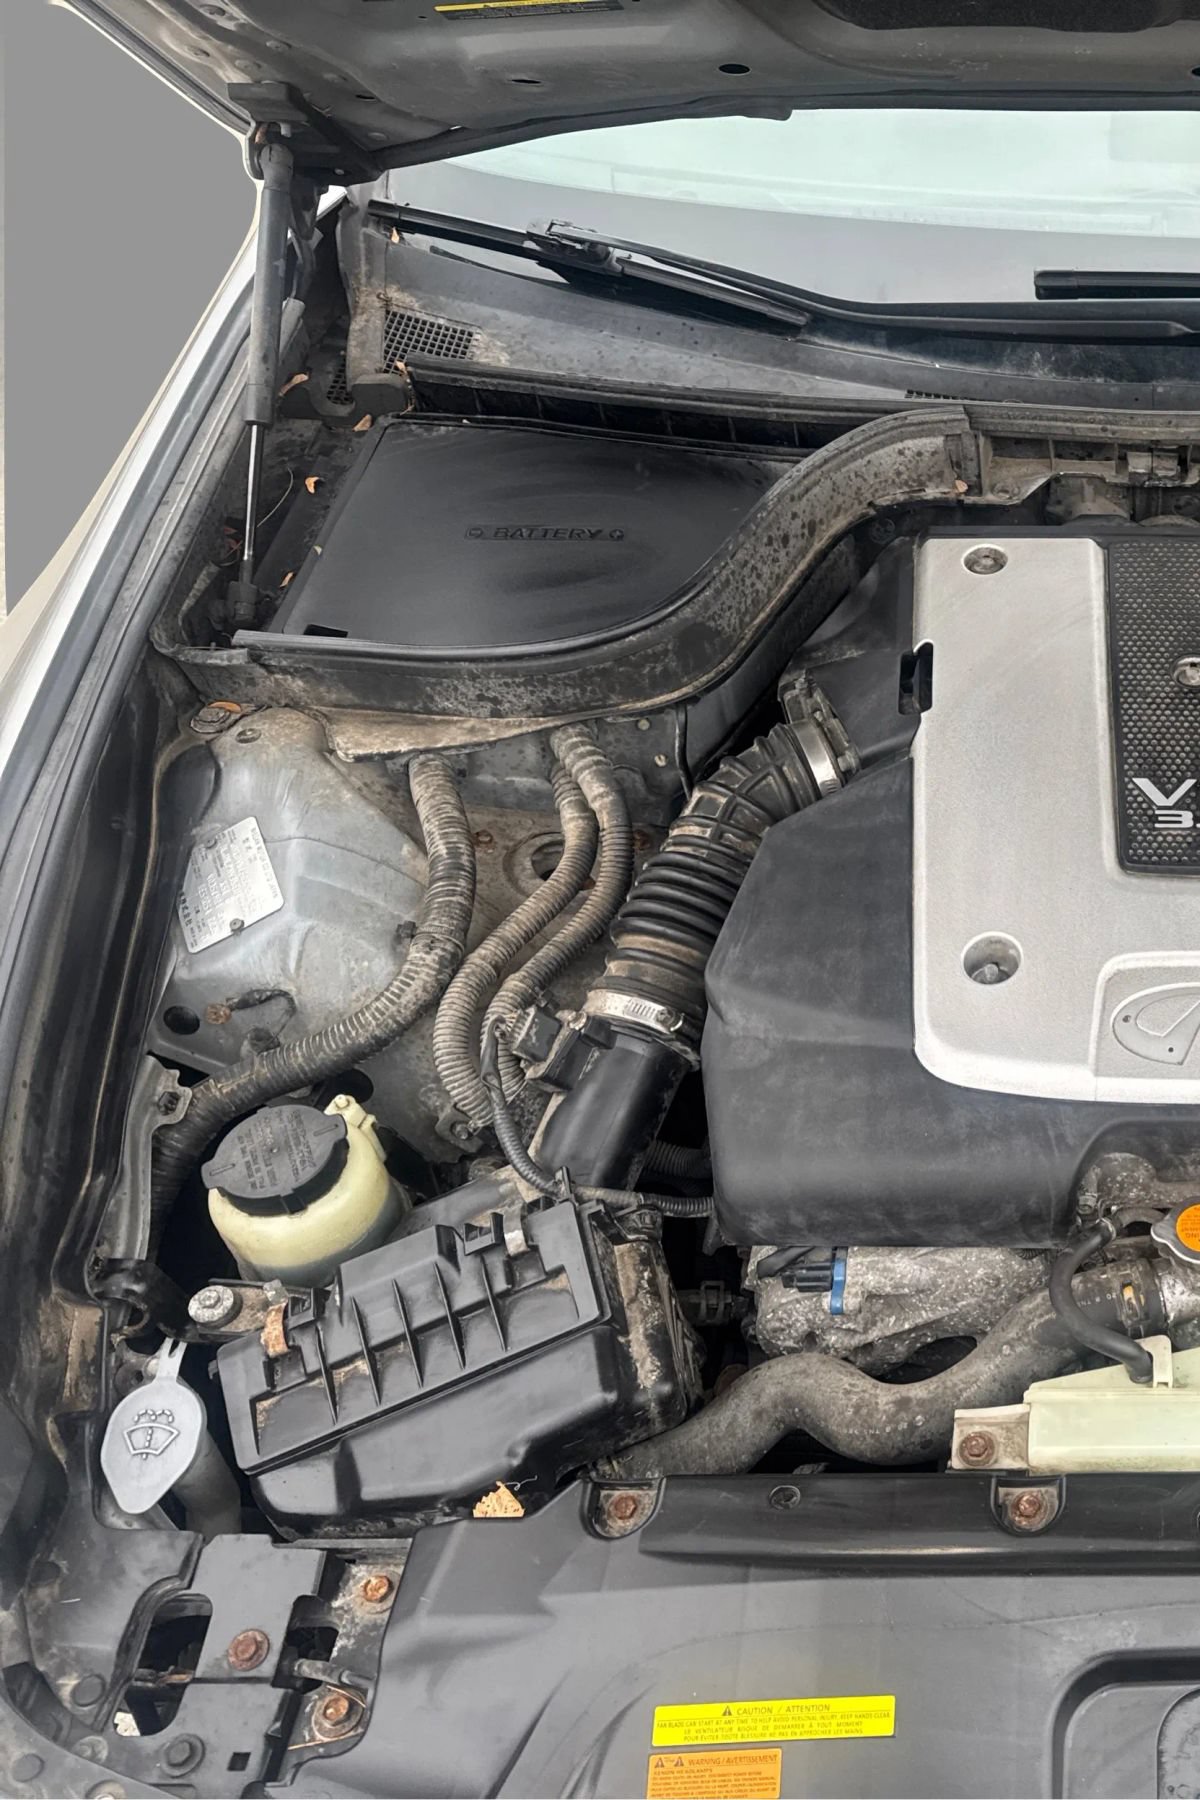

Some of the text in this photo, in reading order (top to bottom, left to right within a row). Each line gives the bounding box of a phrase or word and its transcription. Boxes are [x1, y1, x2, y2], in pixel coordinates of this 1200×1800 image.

[493, 527, 603, 540] BATTERY
[736, 1706, 773, 1716] CAUTION
[785, 1704, 830, 1713] ATTENTION
[688, 1758, 721, 1766] WARNING
[726, 1754, 778, 1764] AVERTISSEMENT
